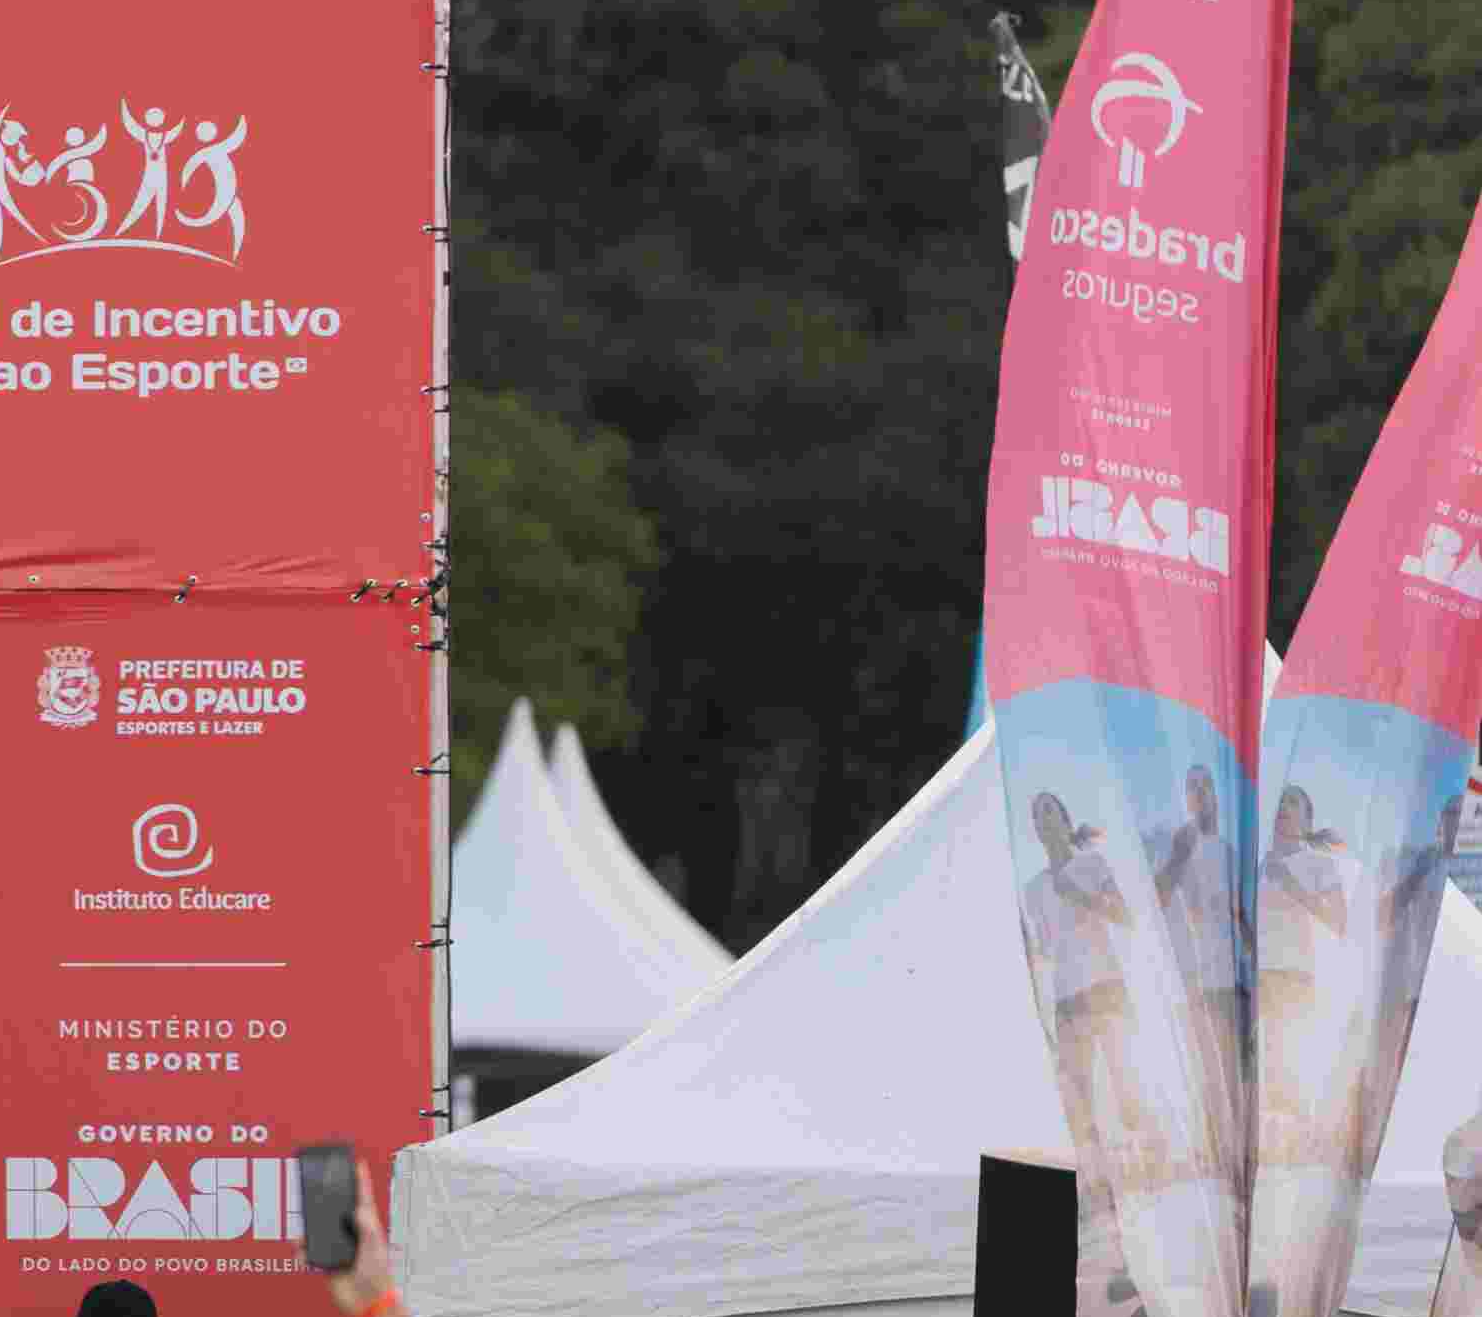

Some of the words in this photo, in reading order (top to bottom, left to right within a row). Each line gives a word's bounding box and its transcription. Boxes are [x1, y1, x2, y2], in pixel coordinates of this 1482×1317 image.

[10, 300, 74, 338] de
[94, 298, 340, 338] Incentivo
[71, 352, 281, 398] Esporte
[119, 659, 266, 680] PREFEITURA
[271, 659, 305, 679] DE
[117, 682, 188, 715] SÃO
[194, 686, 306, 714] PAULO
[116, 721, 196, 735] ESPORTES
[199, 720, 209, 735] E
[213, 720, 264, 735] LAZER
[74, 888, 173, 911] Instituto
[178, 885, 272, 910] Educare
[58, 1015, 233, 1039] MINISTÉRIO
[248, 1019, 287, 1039] DO
[106, 1051, 241, 1072] ESPORTE
[77, 1124, 214, 1143] GOVERNO
[231, 1124, 268, 1143] DO
[22, 1257, 52, 1272] DO
[58, 1257, 111, 1272] LADO
[118, 1258, 148, 1272] DO
[154, 1258, 209, 1272] POVO
[215, 1258, 310, 1273] BRASILEI
